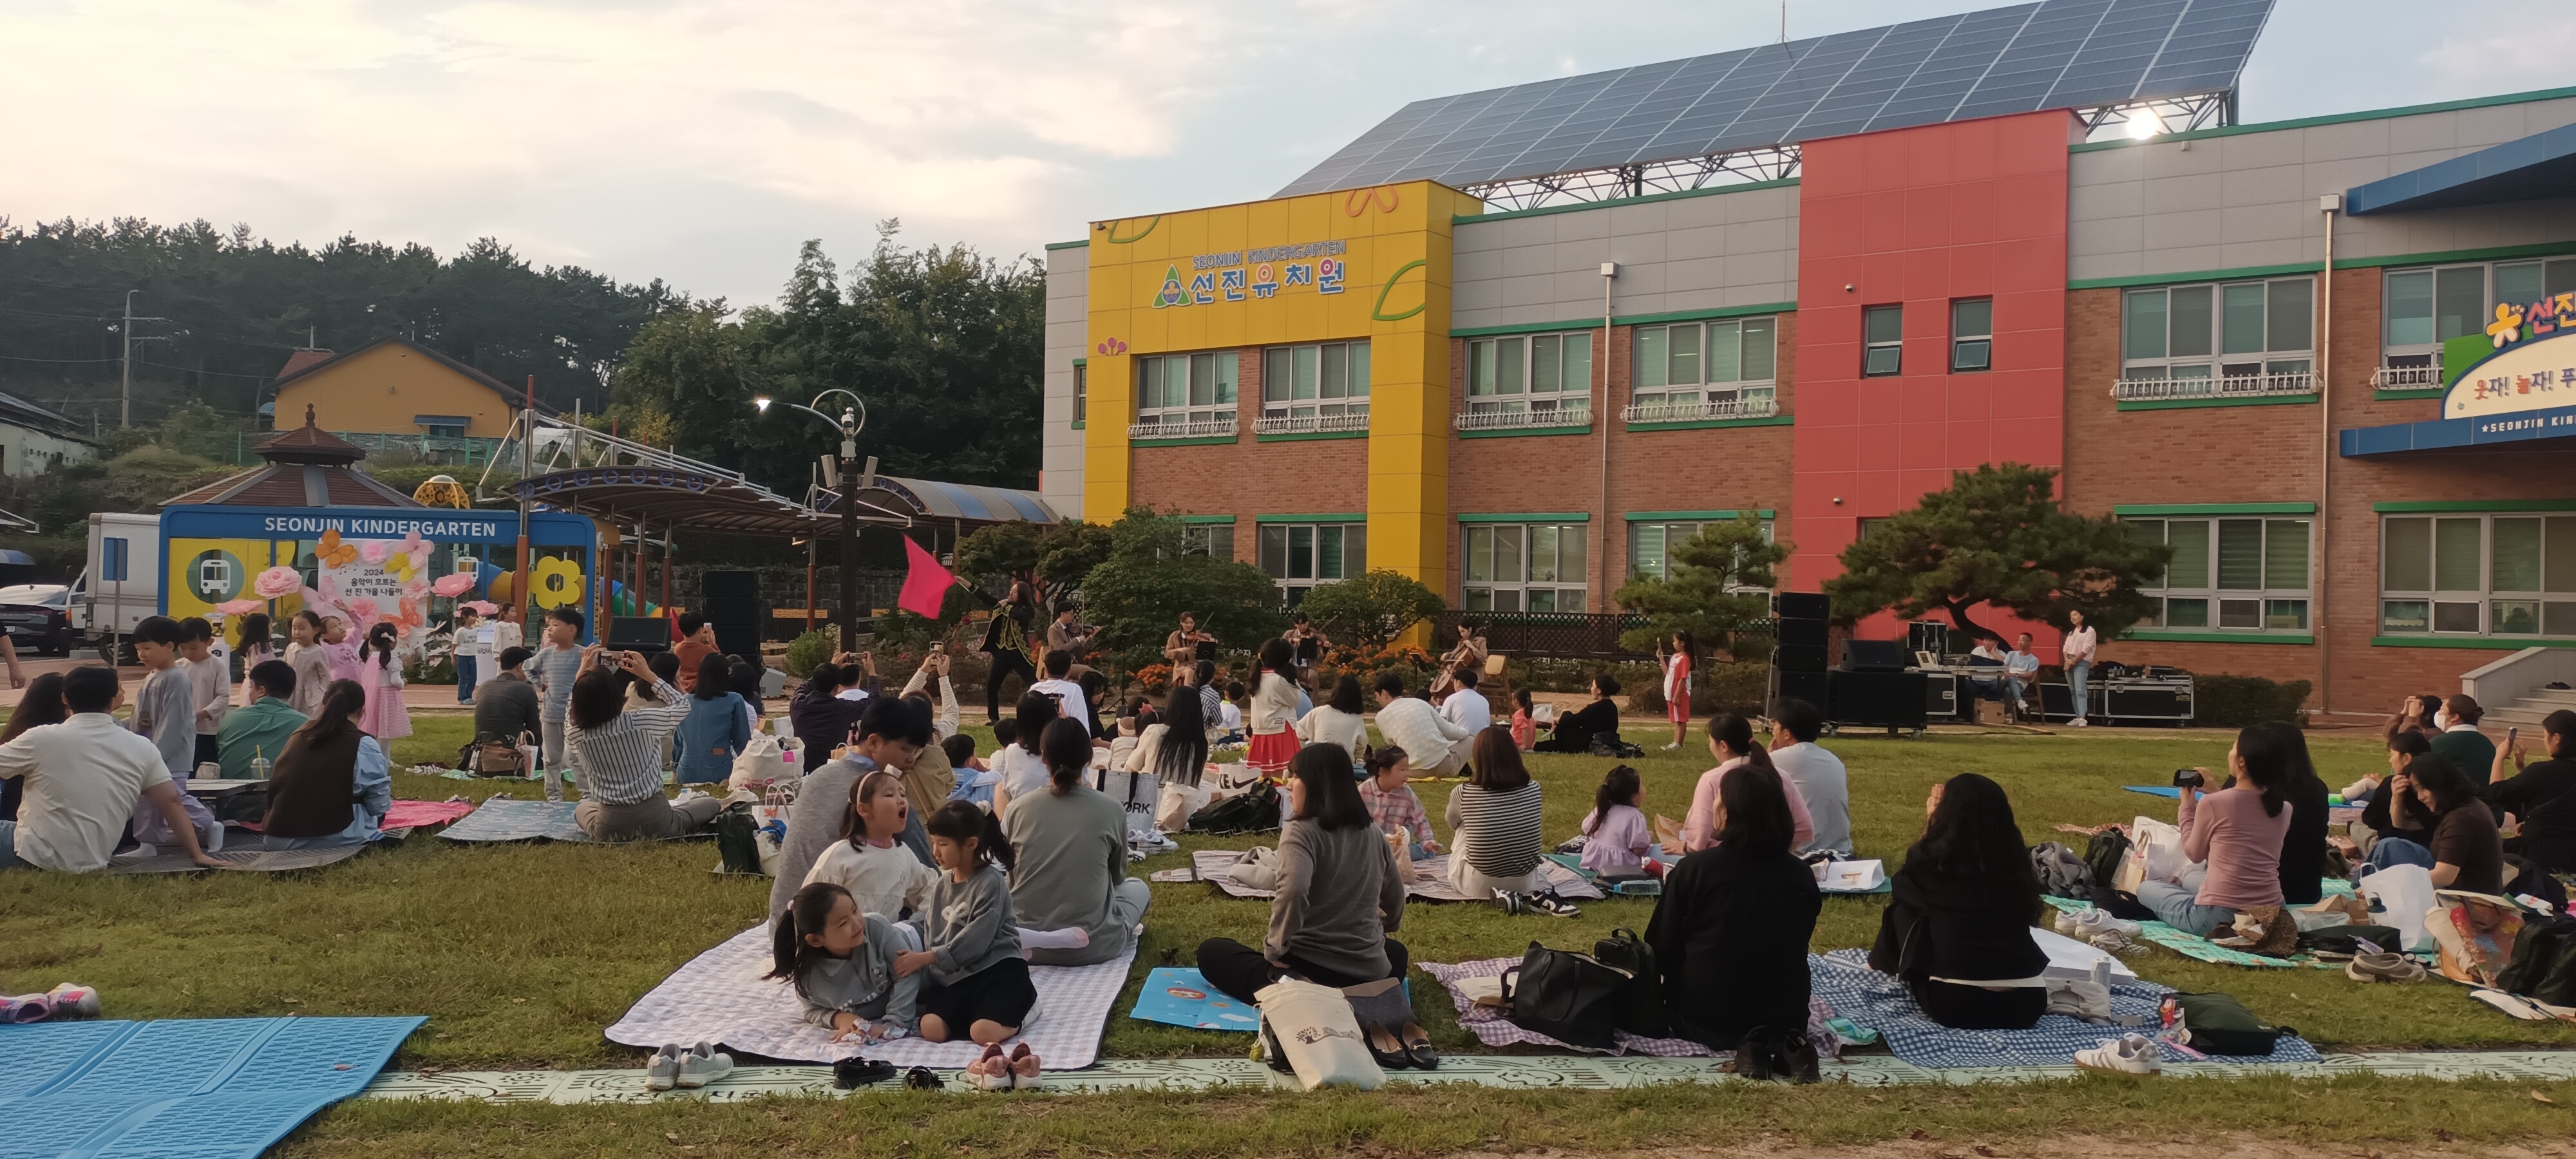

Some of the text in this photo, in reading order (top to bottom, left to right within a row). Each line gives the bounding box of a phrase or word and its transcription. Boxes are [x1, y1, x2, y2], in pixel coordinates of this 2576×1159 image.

[1193, 240, 1345, 269] SEONJIN KINDERGARTEN
[1190, 258, 1344, 303] 선진유치원
[2526, 291, 2576, 334] 선진
[2490, 415, 2576, 433] SEONJIN KIN
[265, 517, 495, 536] SEONJIN KINDERGARTEN
[375, 578, 397, 587] 흐르는
[364, 588, 379, 596] 가을
[381, 588, 402, 596] 나들이
[1121, 801, 1151, 815] ORK
